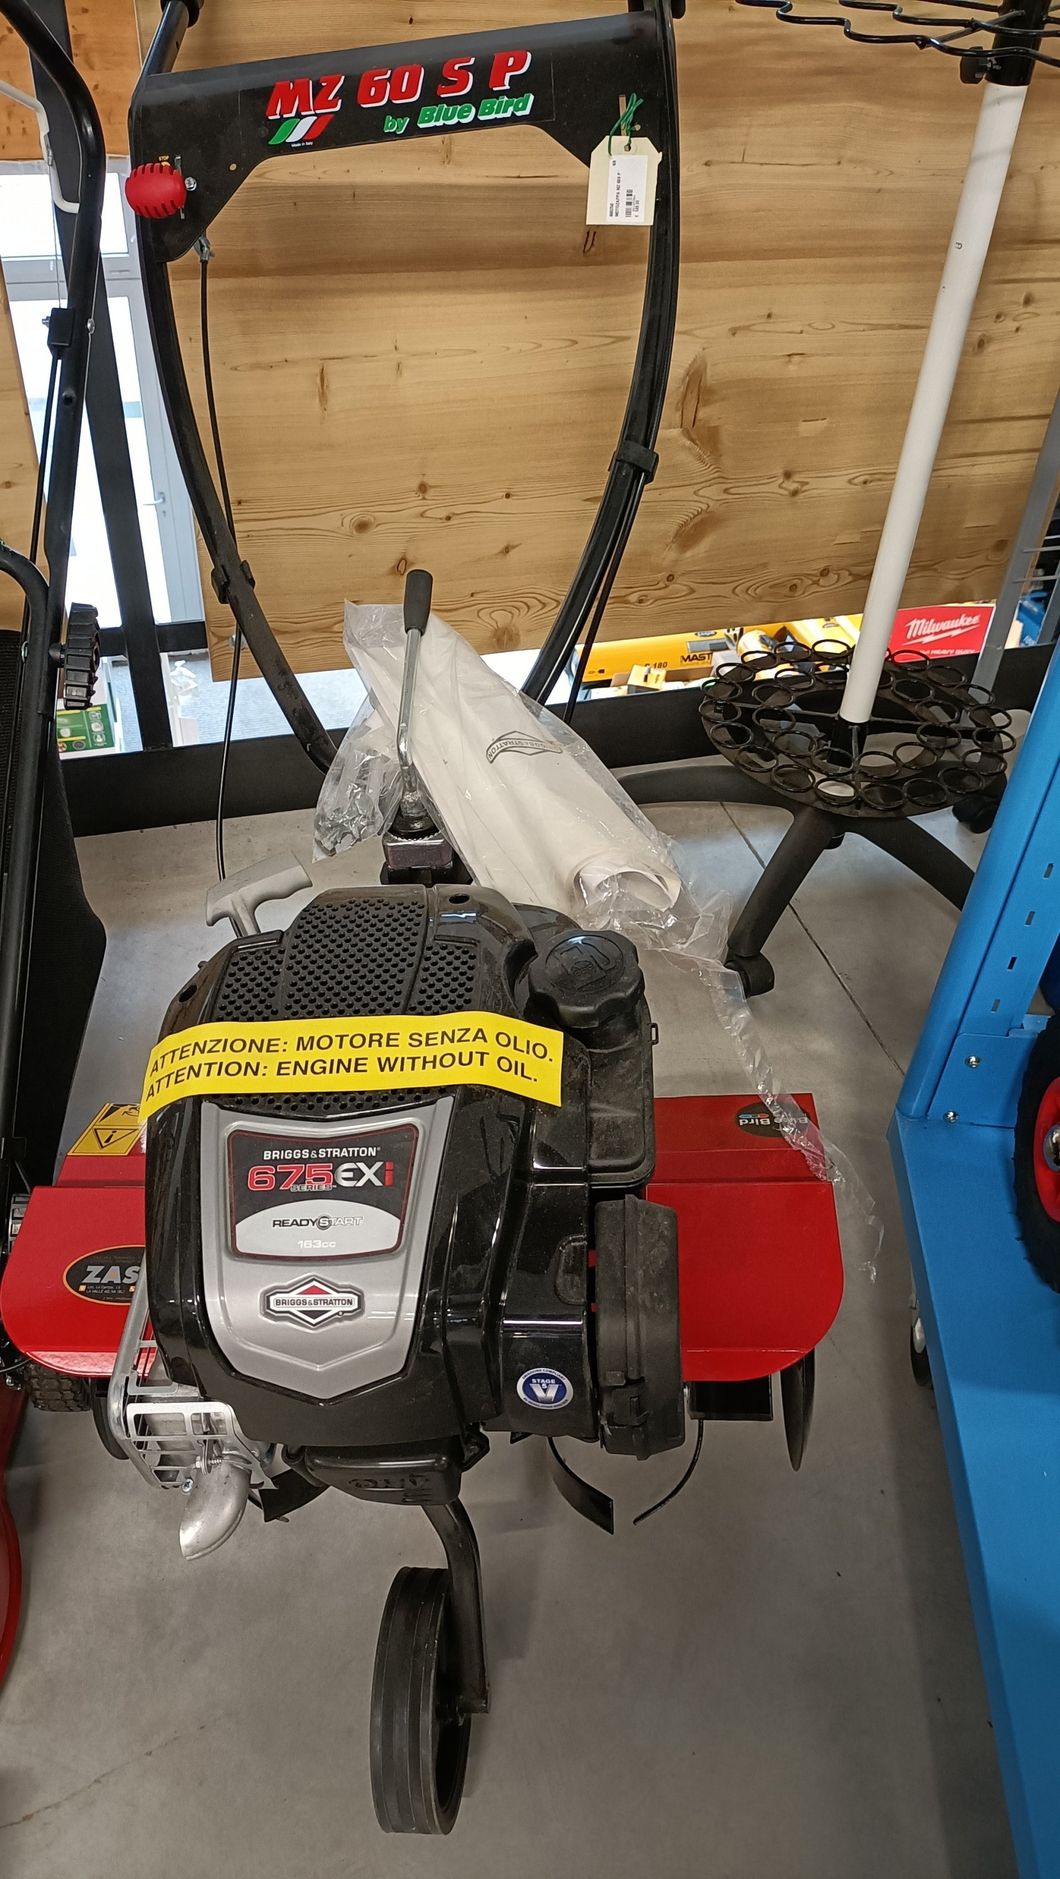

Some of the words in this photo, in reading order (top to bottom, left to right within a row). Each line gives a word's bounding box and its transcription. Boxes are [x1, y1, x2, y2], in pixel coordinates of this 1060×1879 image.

[266, 74, 344, 119] MZ
[357, 64, 423, 108] 60
[437, 56, 475, 97] S
[489, 50, 531, 91] P
[384, 115, 410, 134] by
[417, 103, 476, 128] Blue
[478, 93, 534, 119] Bird
[904, 614, 980, 640] Milwaukee
[149, 1037, 288, 1078] ATTENZIONE:
[296, 1031, 401, 1052] MOTORE
[408, 1026, 489, 1048] SENZA
[495, 1030, 554, 1063] OLIO.
[146, 1060, 268, 1101] ATTENTION:
[276, 1057, 369, 1077] ENGINE
[376, 1050, 490, 1073] WITHOUT
[496, 1056, 539, 1082] OIL.
[263, 1147, 377, 1160] BRIGGS&STRATTON
[297, 1239, 336, 1249] 163cc
[275, 1298, 353, 1306] BRIGGS&STRATTON
